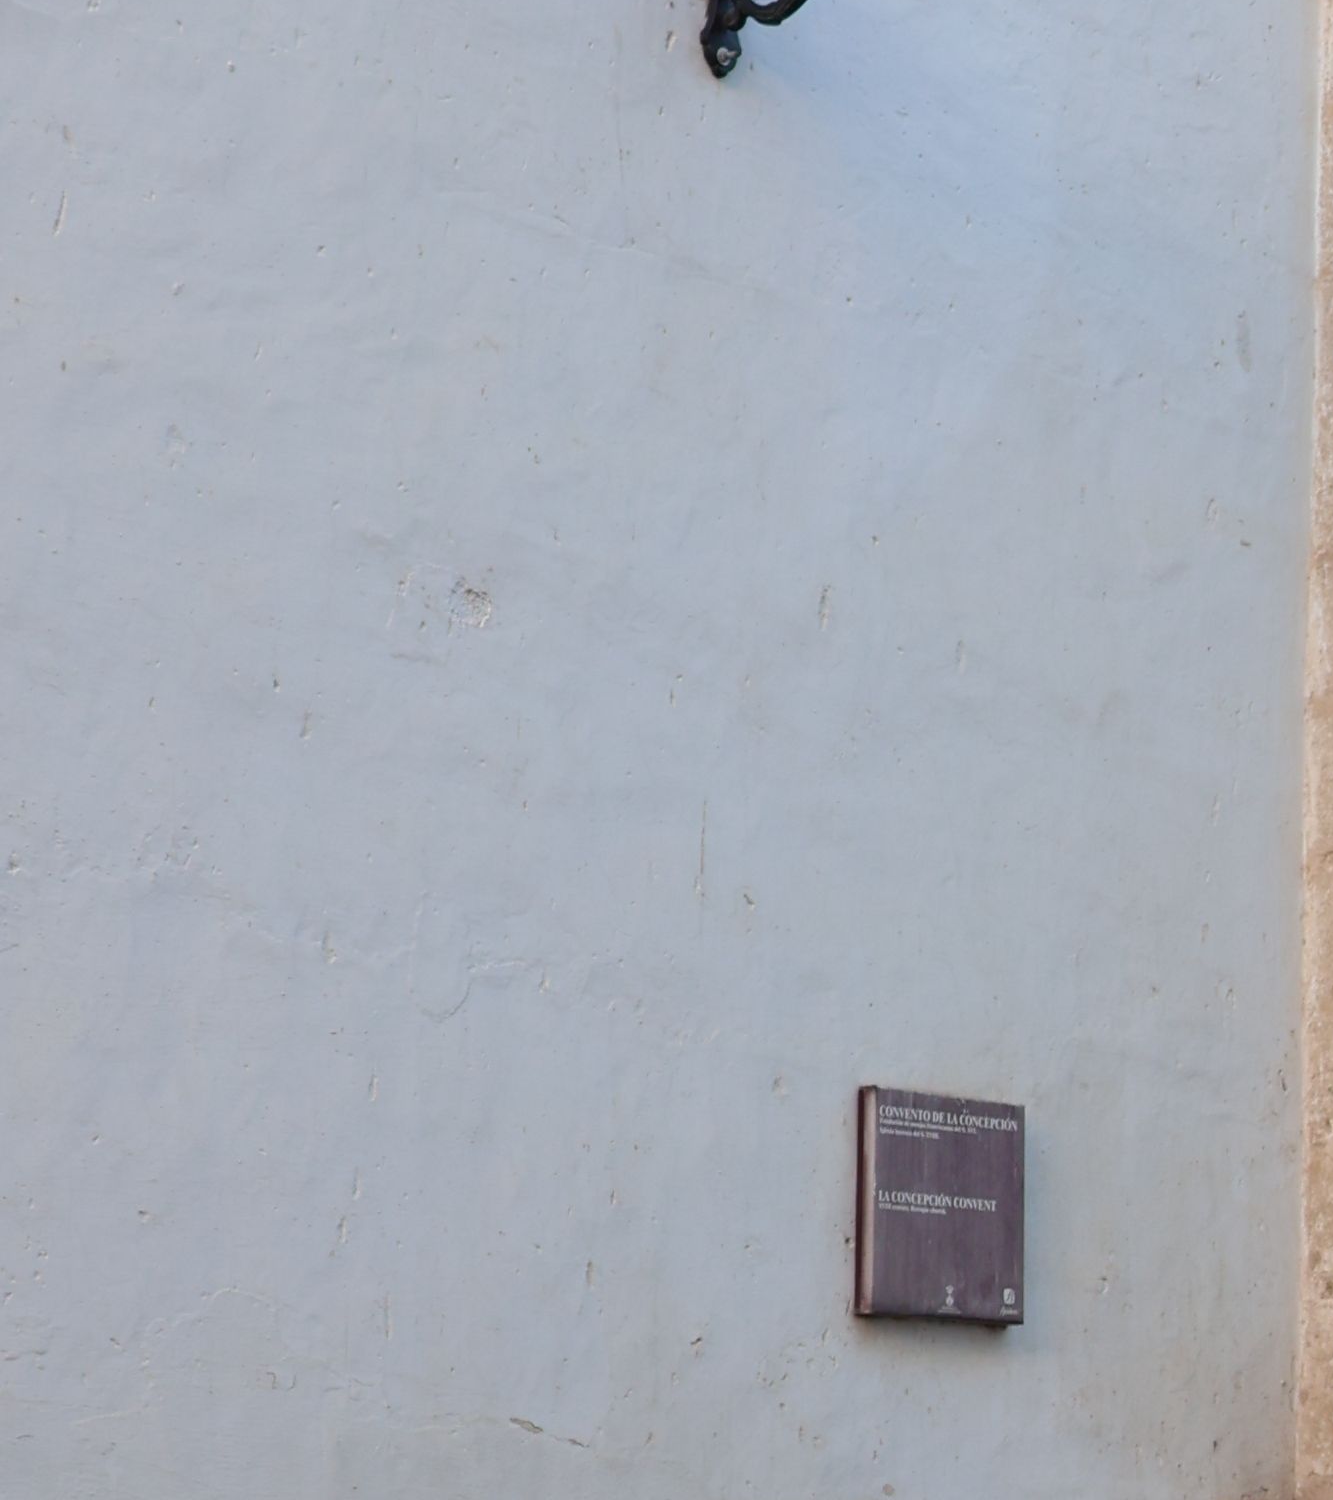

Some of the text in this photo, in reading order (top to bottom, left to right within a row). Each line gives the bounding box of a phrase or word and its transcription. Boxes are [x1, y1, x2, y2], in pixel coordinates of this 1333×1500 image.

[879, 1104, 931, 1121] CONVENTO
[932, 1110, 945, 1124] DE
[946, 1112, 958, 1125] LA
[959, 1113, 1018, 1132] CONCEPCIÓN
[879, 1190, 890, 1202] LA
[891, 1191, 952, 1208] CONCEPCIÓN
[953, 1196, 997, 1212] CONVENT
